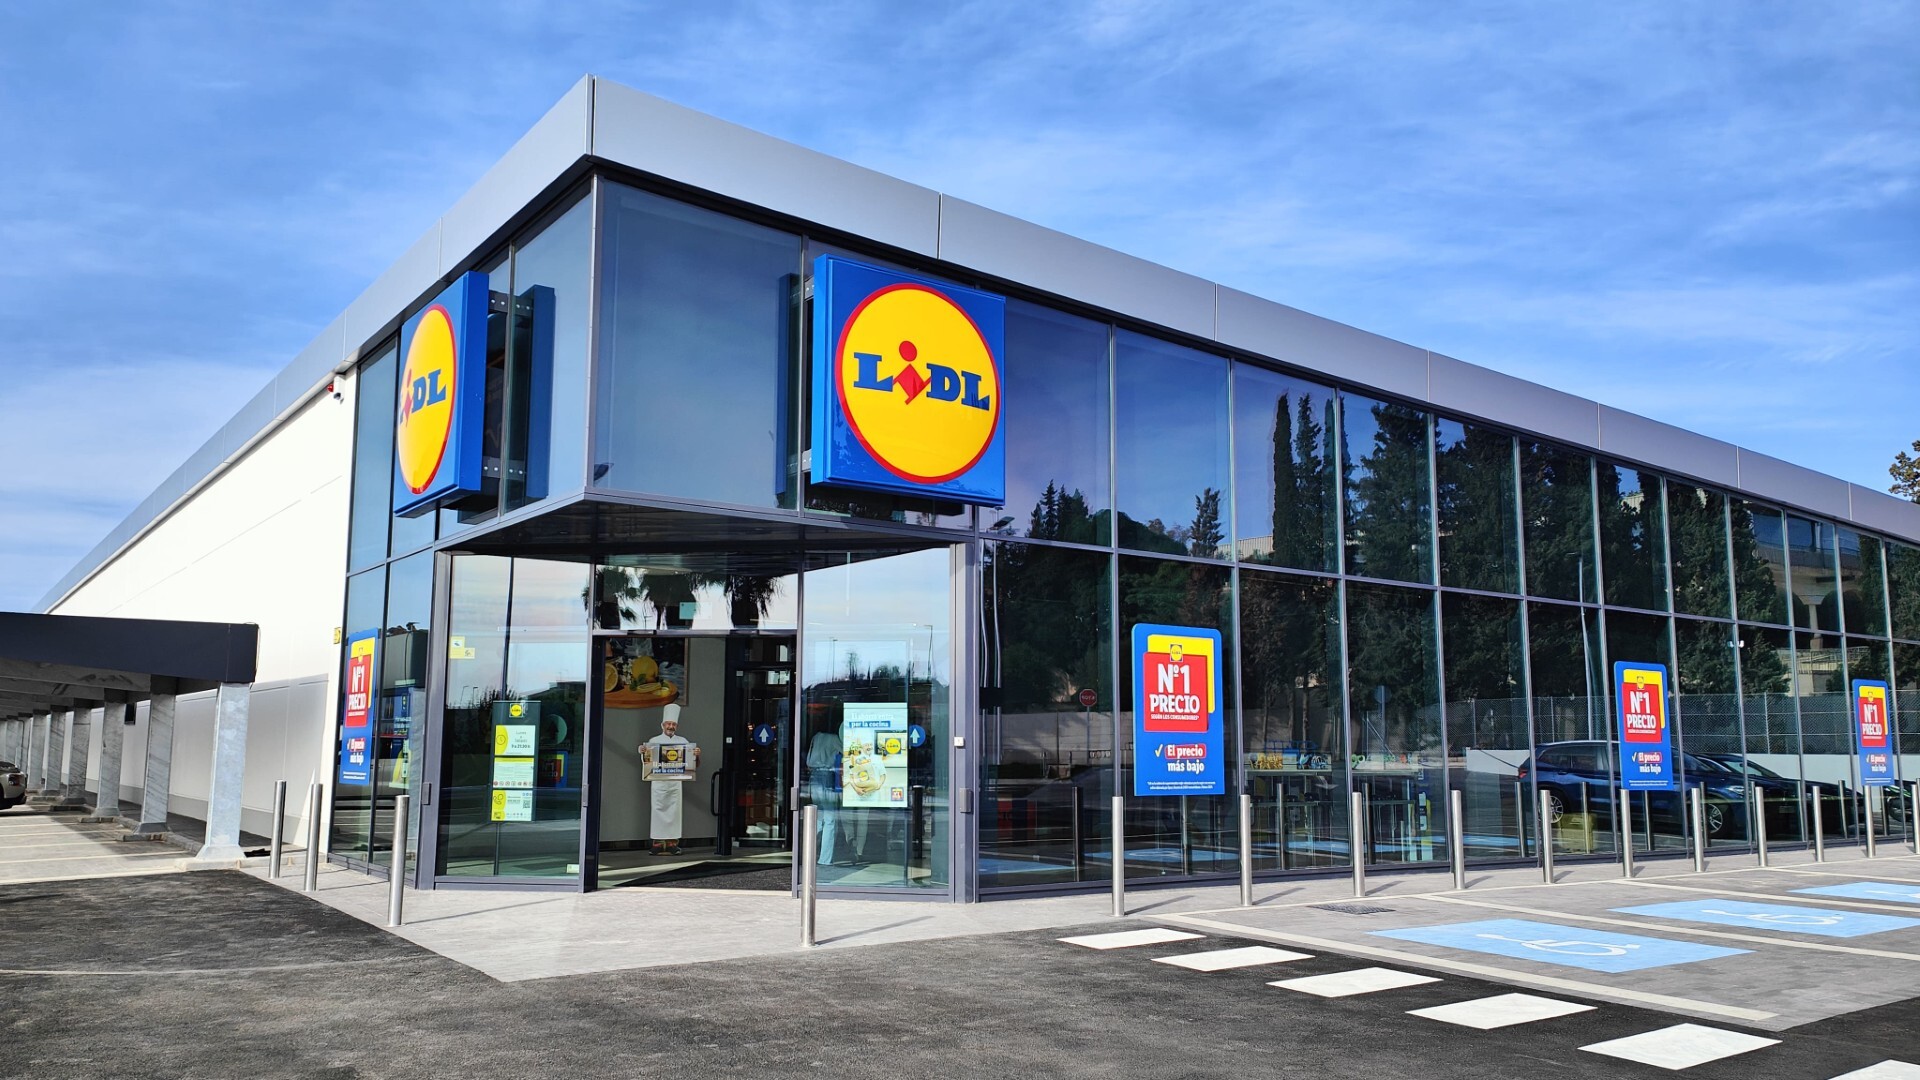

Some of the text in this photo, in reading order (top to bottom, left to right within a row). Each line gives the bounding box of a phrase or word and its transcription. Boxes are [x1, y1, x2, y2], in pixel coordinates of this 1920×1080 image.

[348, 693, 367, 711] PRECIO
[1149, 694, 1201, 714] PRECIO
[1626, 714, 1657, 729] PRECIO
[1862, 723, 1882, 736] PRECIO
[1167, 744, 1204, 759] El precio
[1638, 753, 1660, 763] El precio
[1167, 759, 1205, 775] más bajo
[1639, 763, 1662, 774] más bajo
